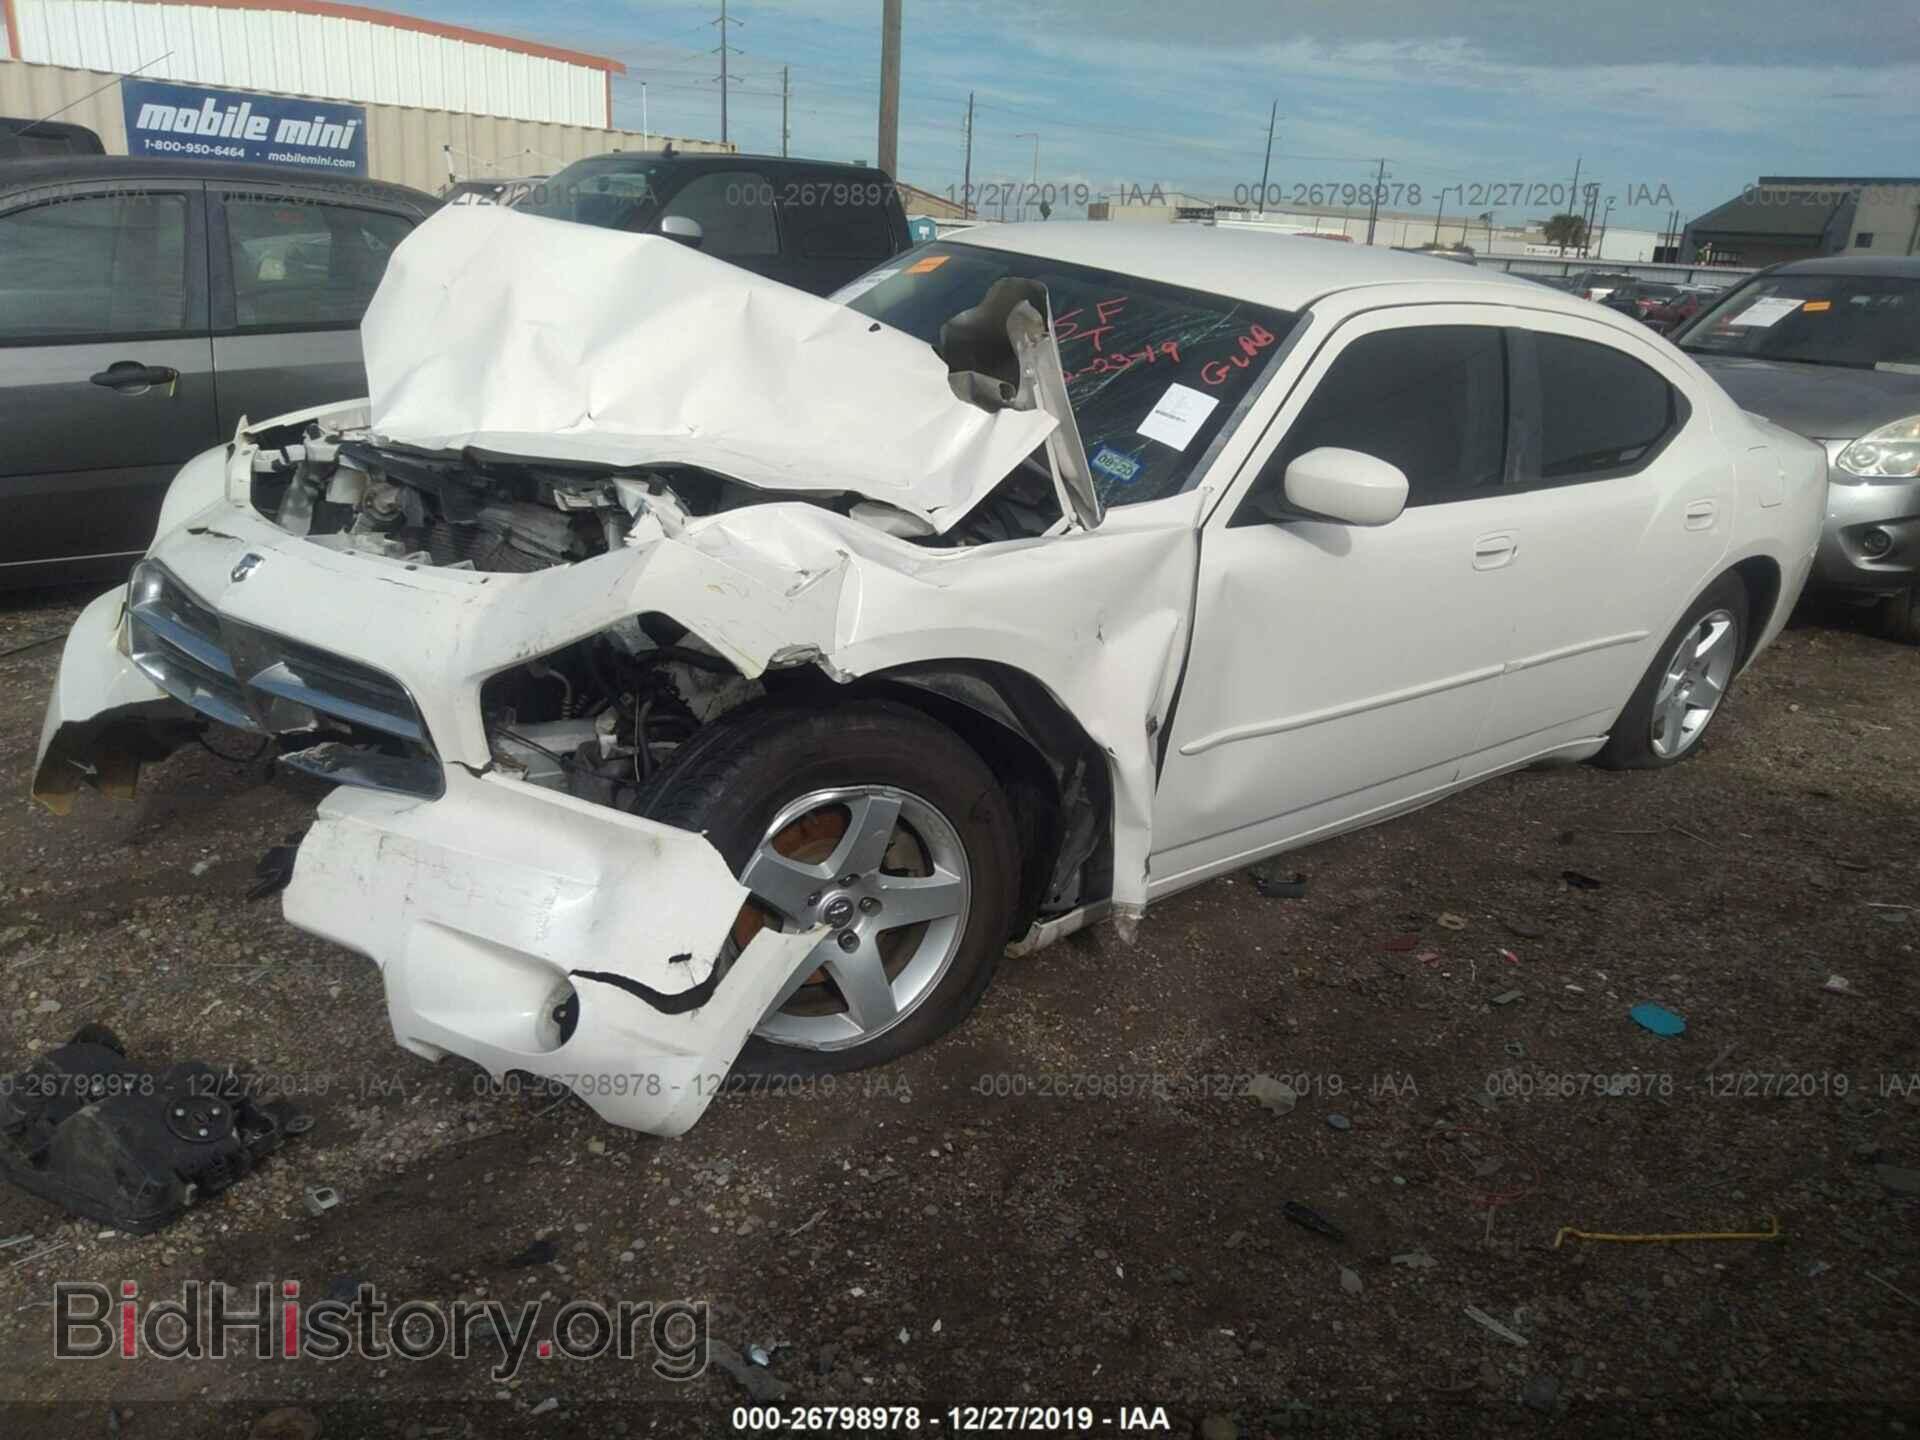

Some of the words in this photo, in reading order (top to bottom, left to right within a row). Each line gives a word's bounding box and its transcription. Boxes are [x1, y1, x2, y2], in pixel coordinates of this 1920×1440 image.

[136, 98, 270, 141] mobile
[274, 116, 357, 149] mini
[144, 139, 245, 158] 1-800-950-6464
[268, 151, 356, 168] mobilemini.com
